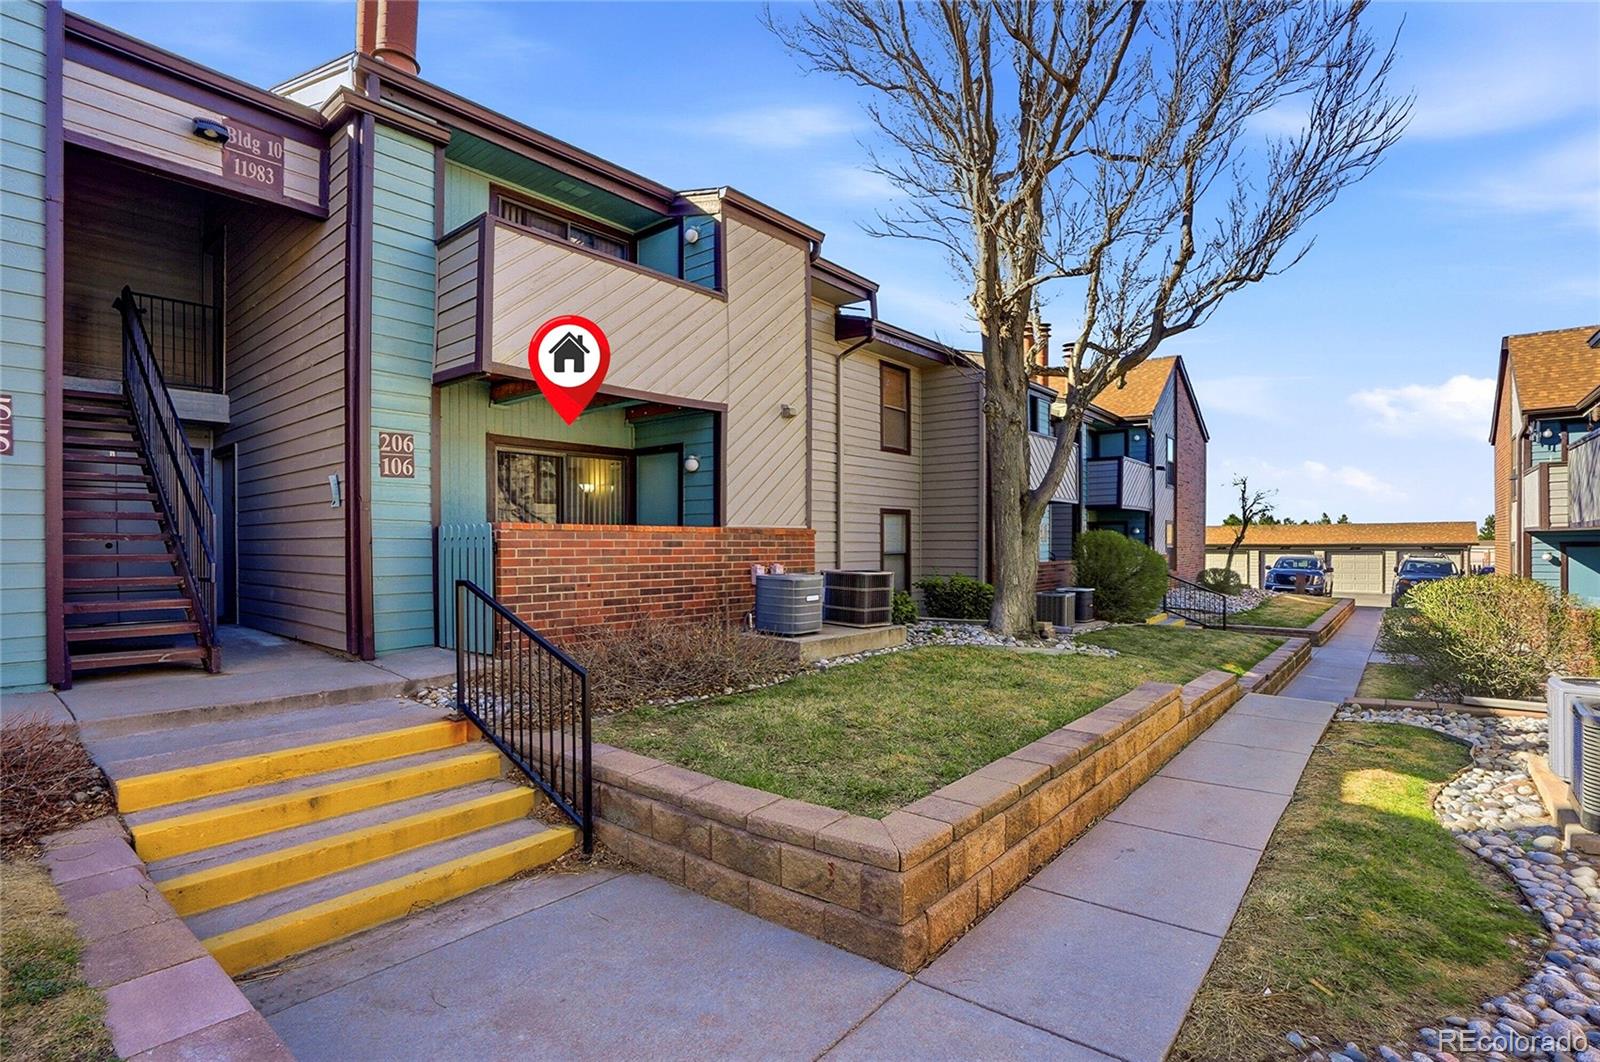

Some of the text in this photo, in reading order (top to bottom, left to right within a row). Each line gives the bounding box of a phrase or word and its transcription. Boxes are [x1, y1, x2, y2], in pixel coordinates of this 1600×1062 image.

[227, 126, 283, 159] Bldg 10
[234, 158, 274, 185] 11983
[380, 433, 414, 453] 206
[382, 457, 413, 476] 106
